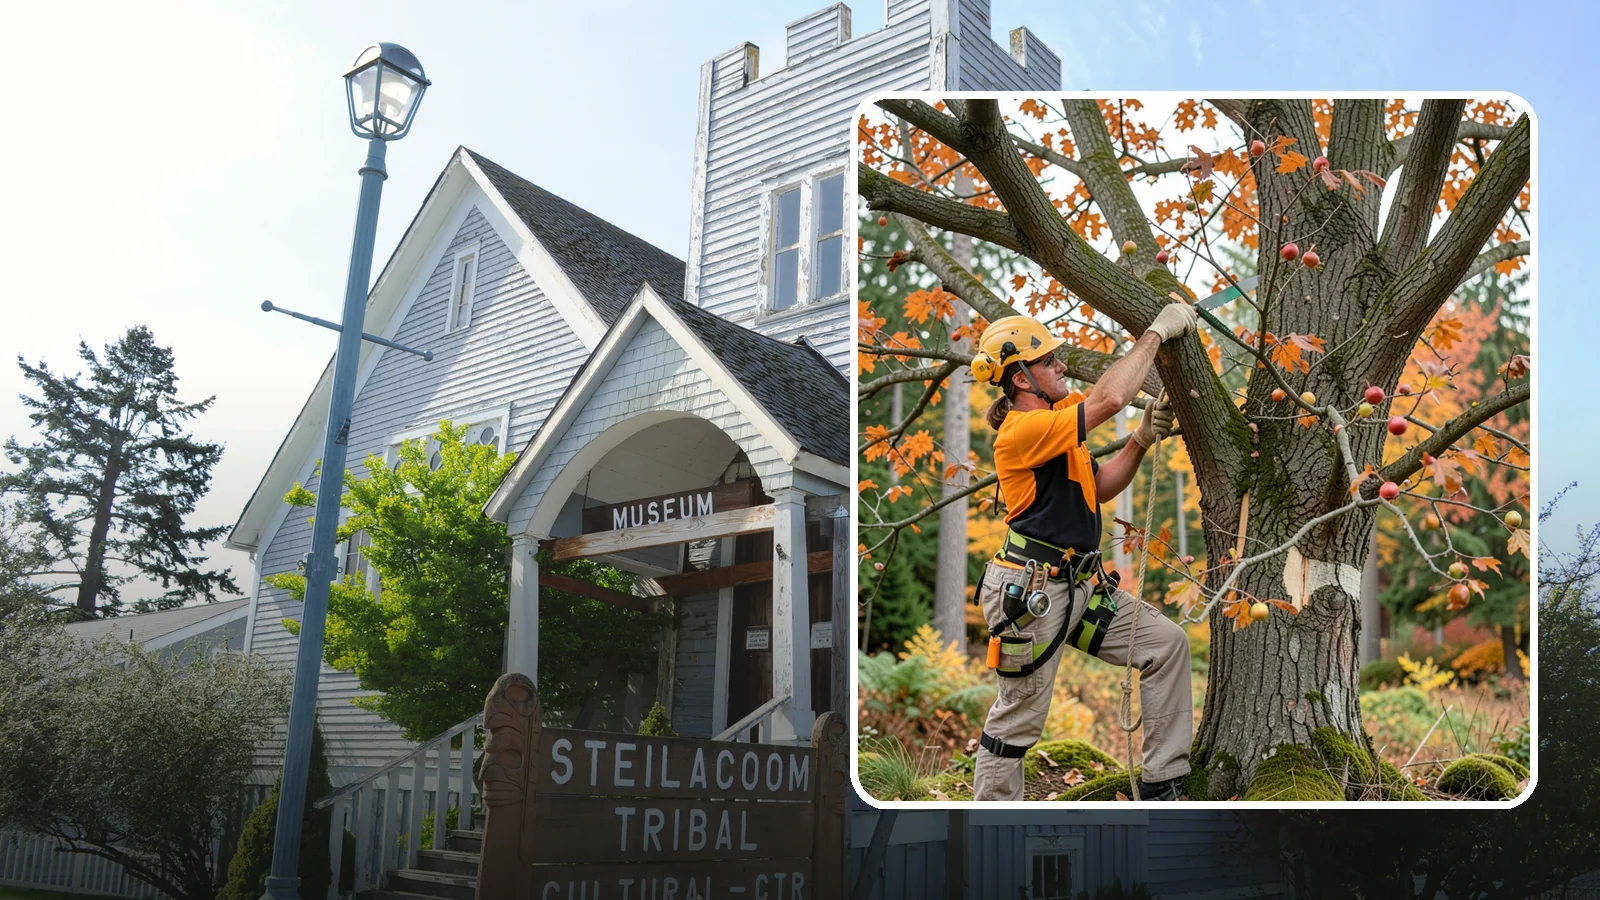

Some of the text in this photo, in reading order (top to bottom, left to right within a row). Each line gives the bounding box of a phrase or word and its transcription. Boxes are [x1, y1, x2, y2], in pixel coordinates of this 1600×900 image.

[613, 491, 713, 531] MUSEUM
[550, 738, 809, 792] STEILACOOM
[614, 807, 757, 851] TRIBAL
